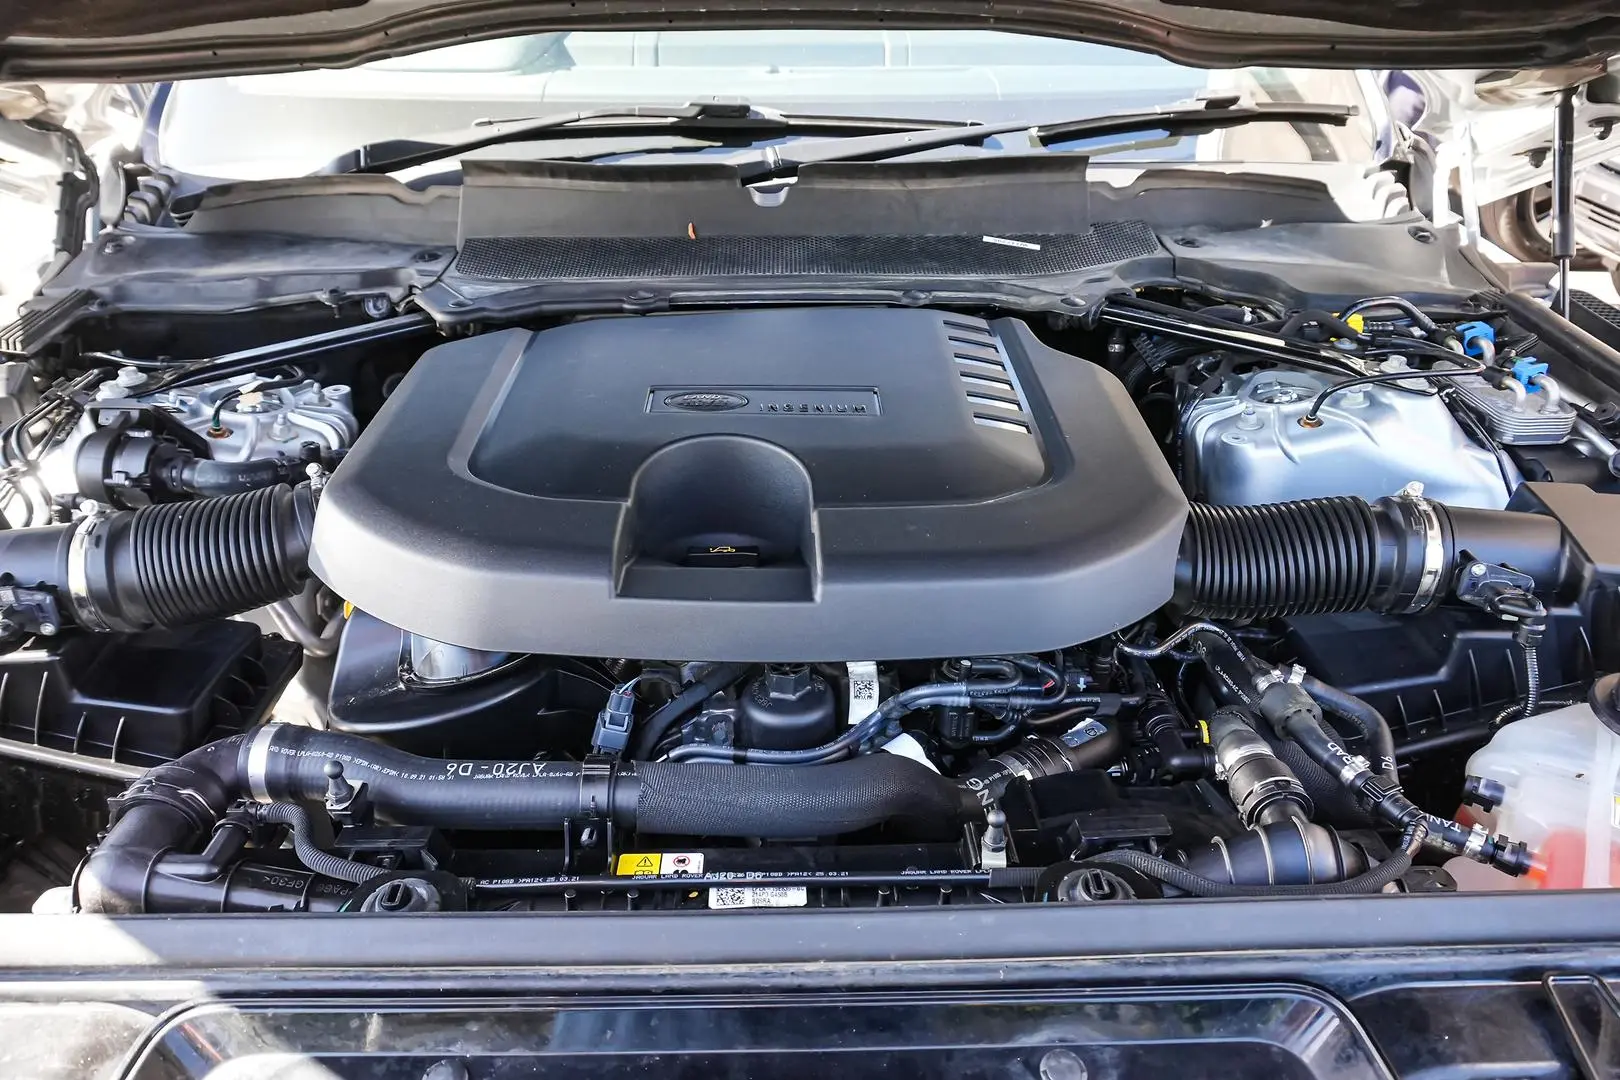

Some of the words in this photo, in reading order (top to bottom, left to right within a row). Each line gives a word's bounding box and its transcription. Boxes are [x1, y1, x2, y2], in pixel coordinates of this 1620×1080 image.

[758, 402, 867, 414] INGENIUM
[1327, 742, 1354, 765] RAD
[445, 762, 474, 776] D6
[492, 761, 548, 776] AJ20
[1382, 755, 1394, 770] D6
